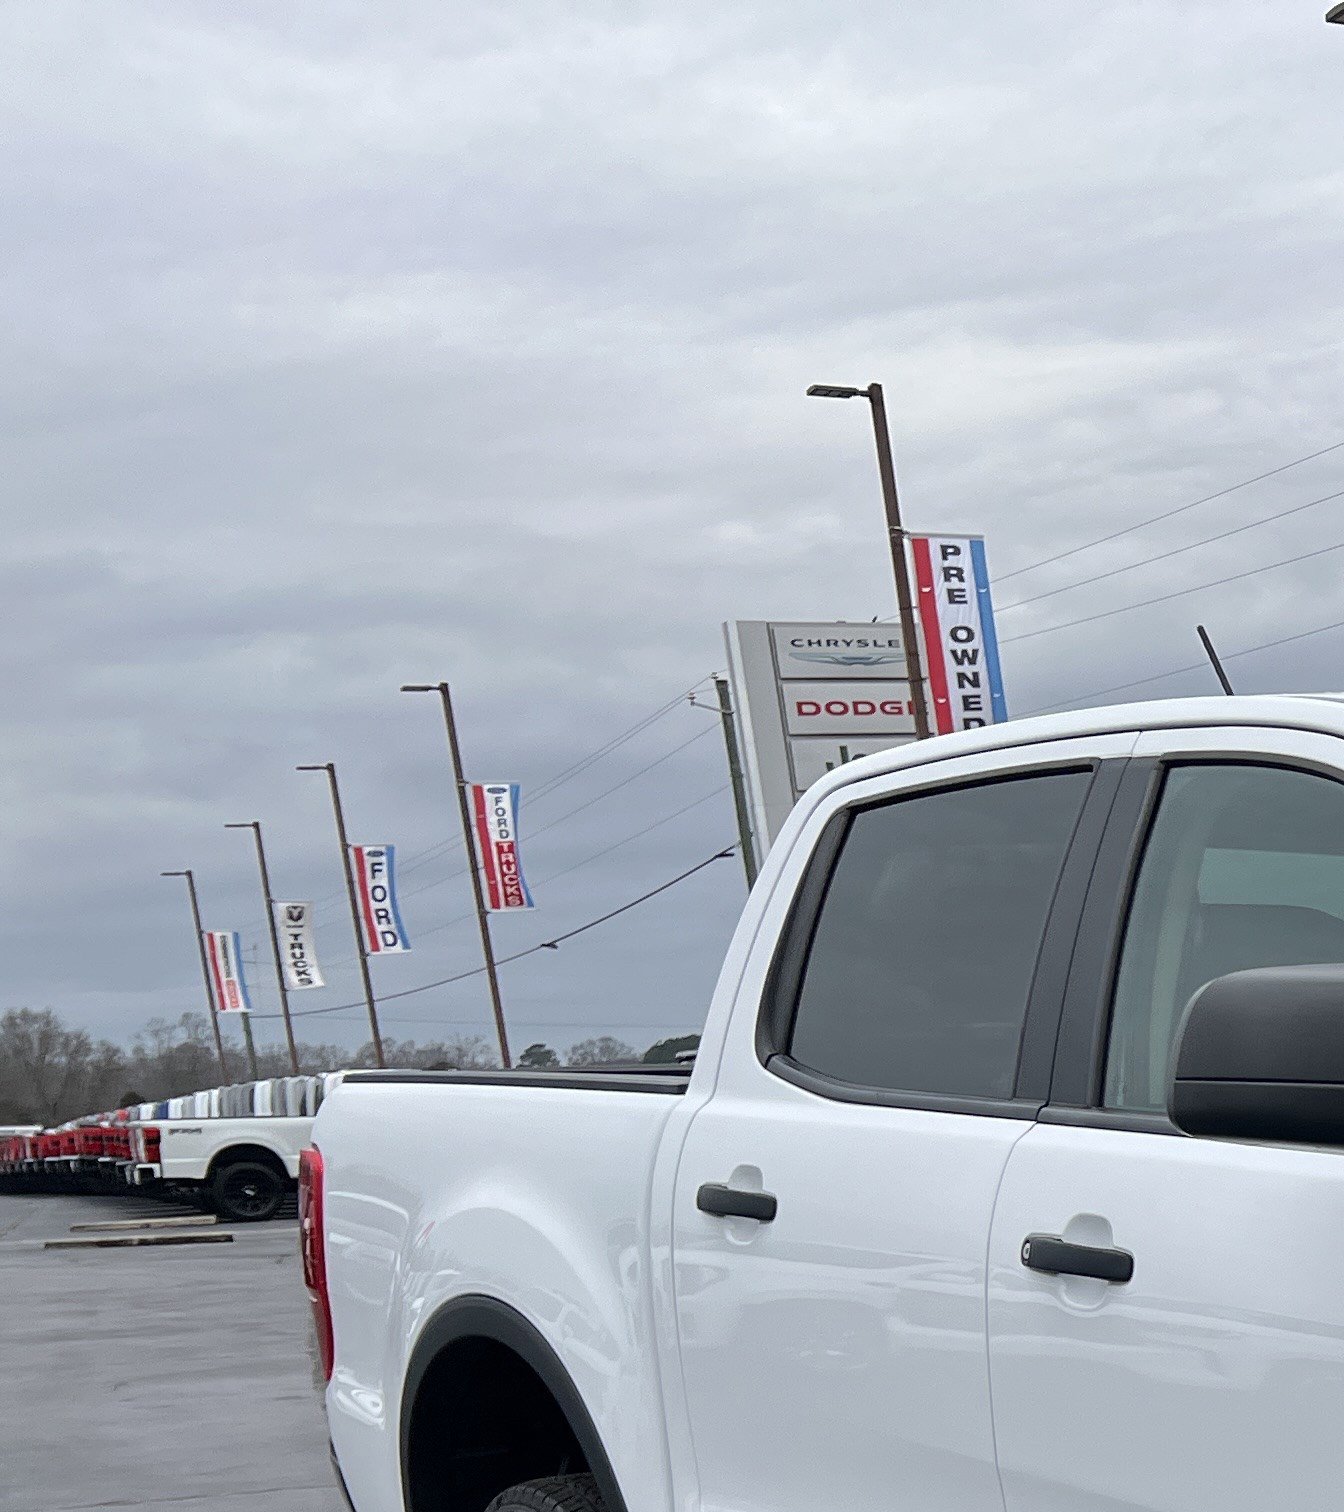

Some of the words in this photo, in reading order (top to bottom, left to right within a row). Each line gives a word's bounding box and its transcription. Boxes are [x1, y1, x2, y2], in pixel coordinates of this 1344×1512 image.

[940, 544, 968, 605] PRE
[790, 638, 900, 649] CHRYSLE
[950, 625, 987, 731] OWNED
[494, 796, 510, 840] FORD
[370, 862, 398, 947] FORD
